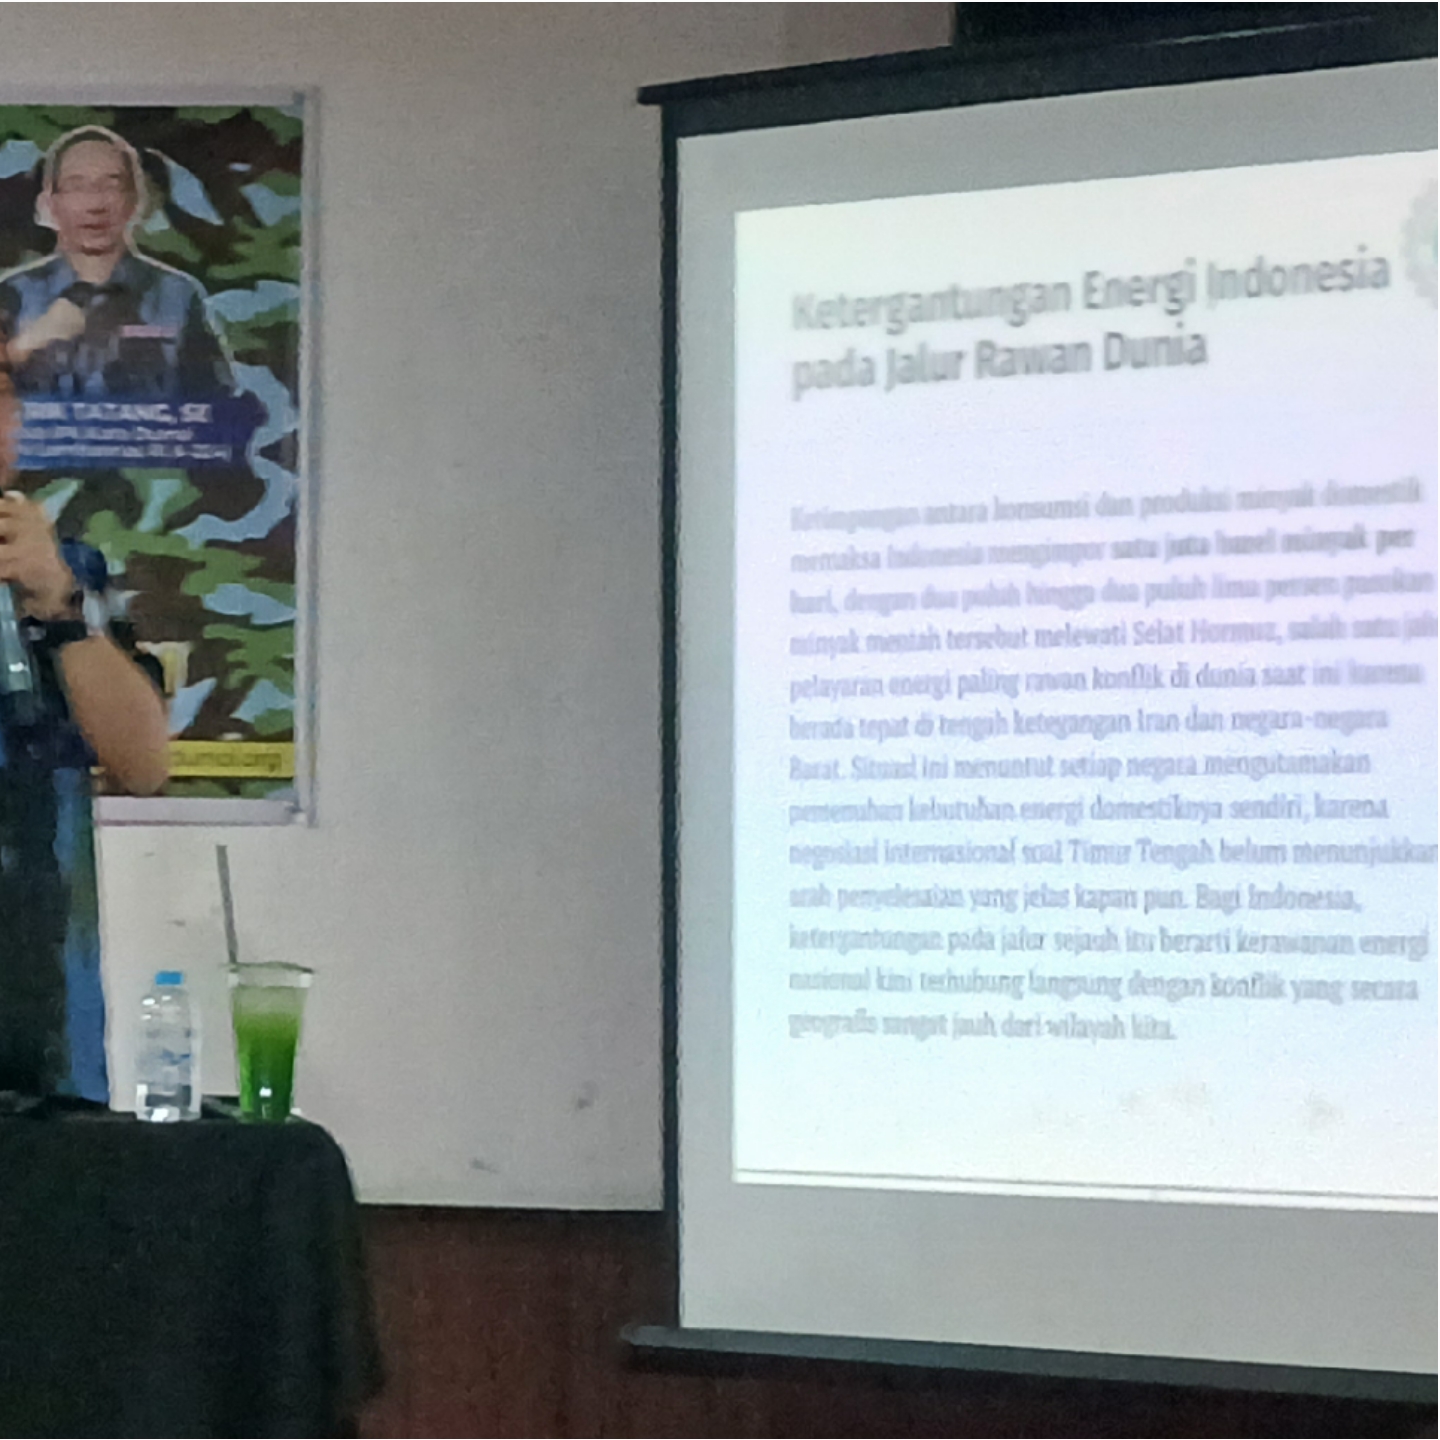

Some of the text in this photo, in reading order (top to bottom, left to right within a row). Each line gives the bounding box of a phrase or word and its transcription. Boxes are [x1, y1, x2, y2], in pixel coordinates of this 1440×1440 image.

[793, 244, 1390, 336] Ketergantungan Energi Indonesia
[794, 319, 1207, 401] pada Jalur Rawan Dunia
